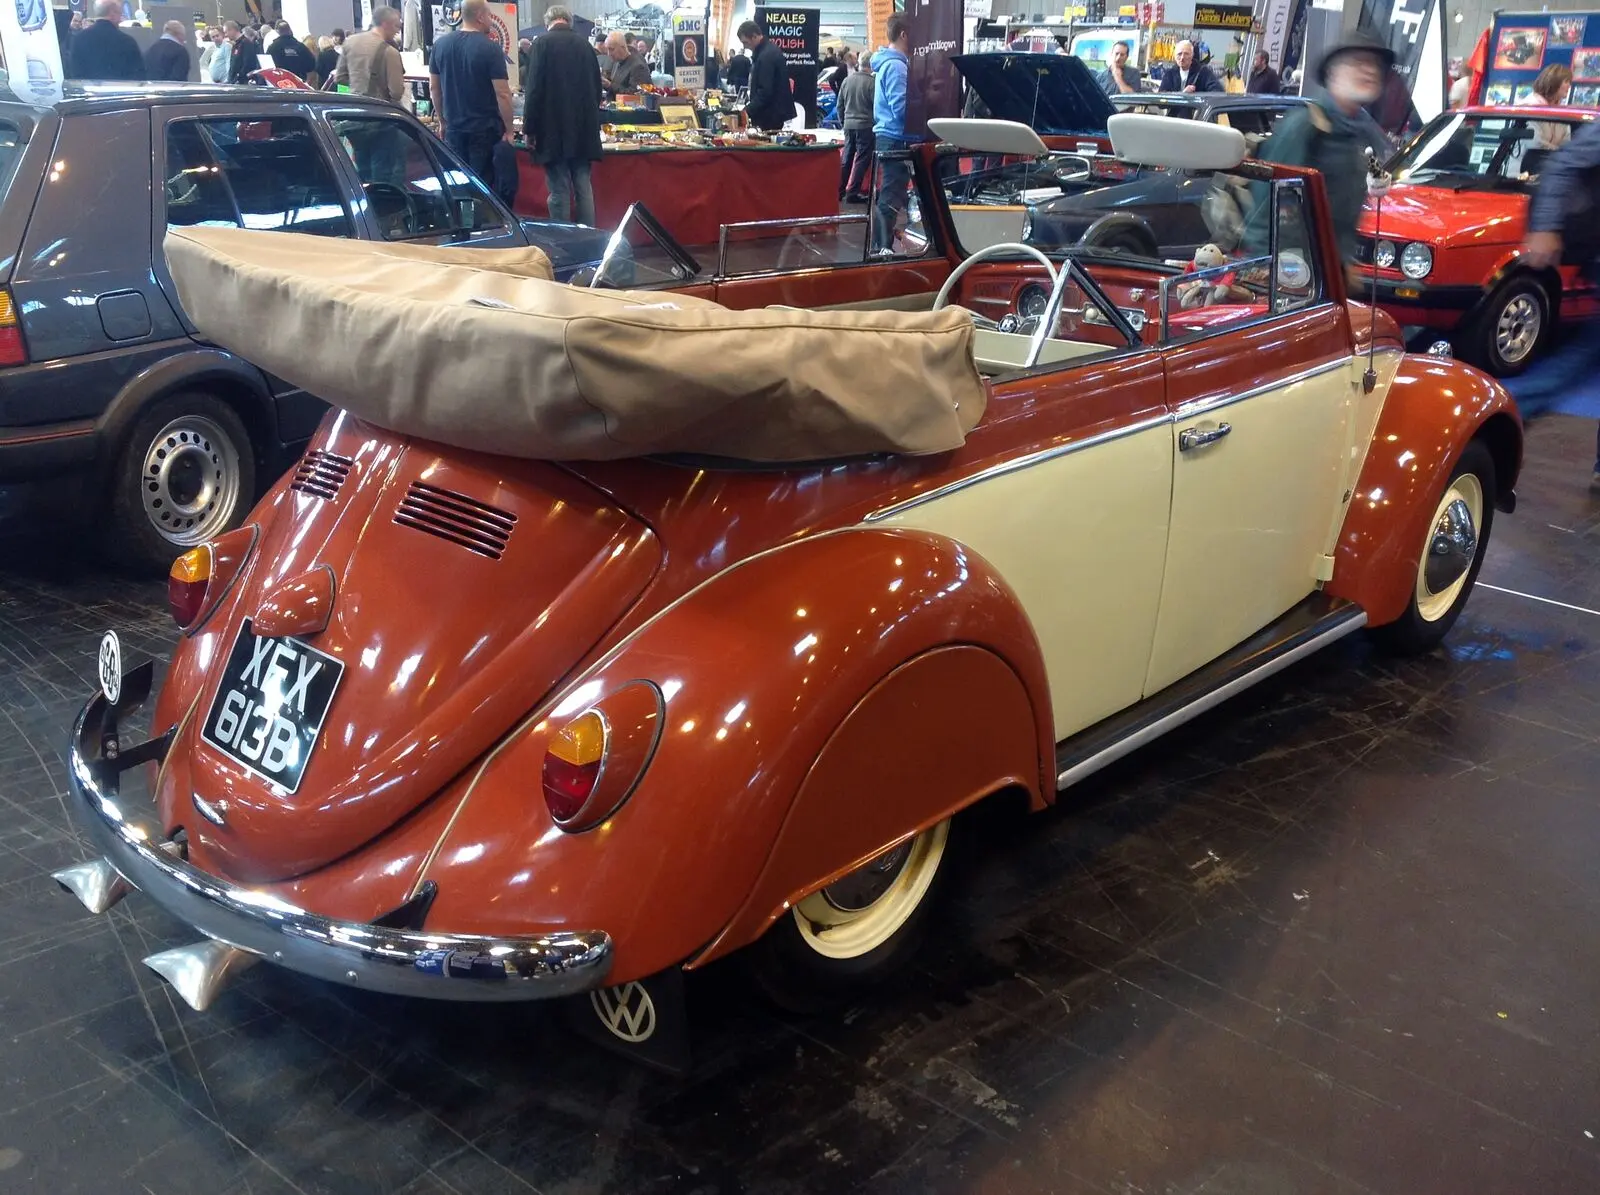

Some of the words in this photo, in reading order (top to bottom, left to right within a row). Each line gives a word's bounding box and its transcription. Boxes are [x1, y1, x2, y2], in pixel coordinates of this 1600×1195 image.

[766, 13, 806, 24] NEALES
[678, 20, 701, 31] BMC
[769, 25, 803, 37] MAGIC
[215, 689, 299, 773] 613B
